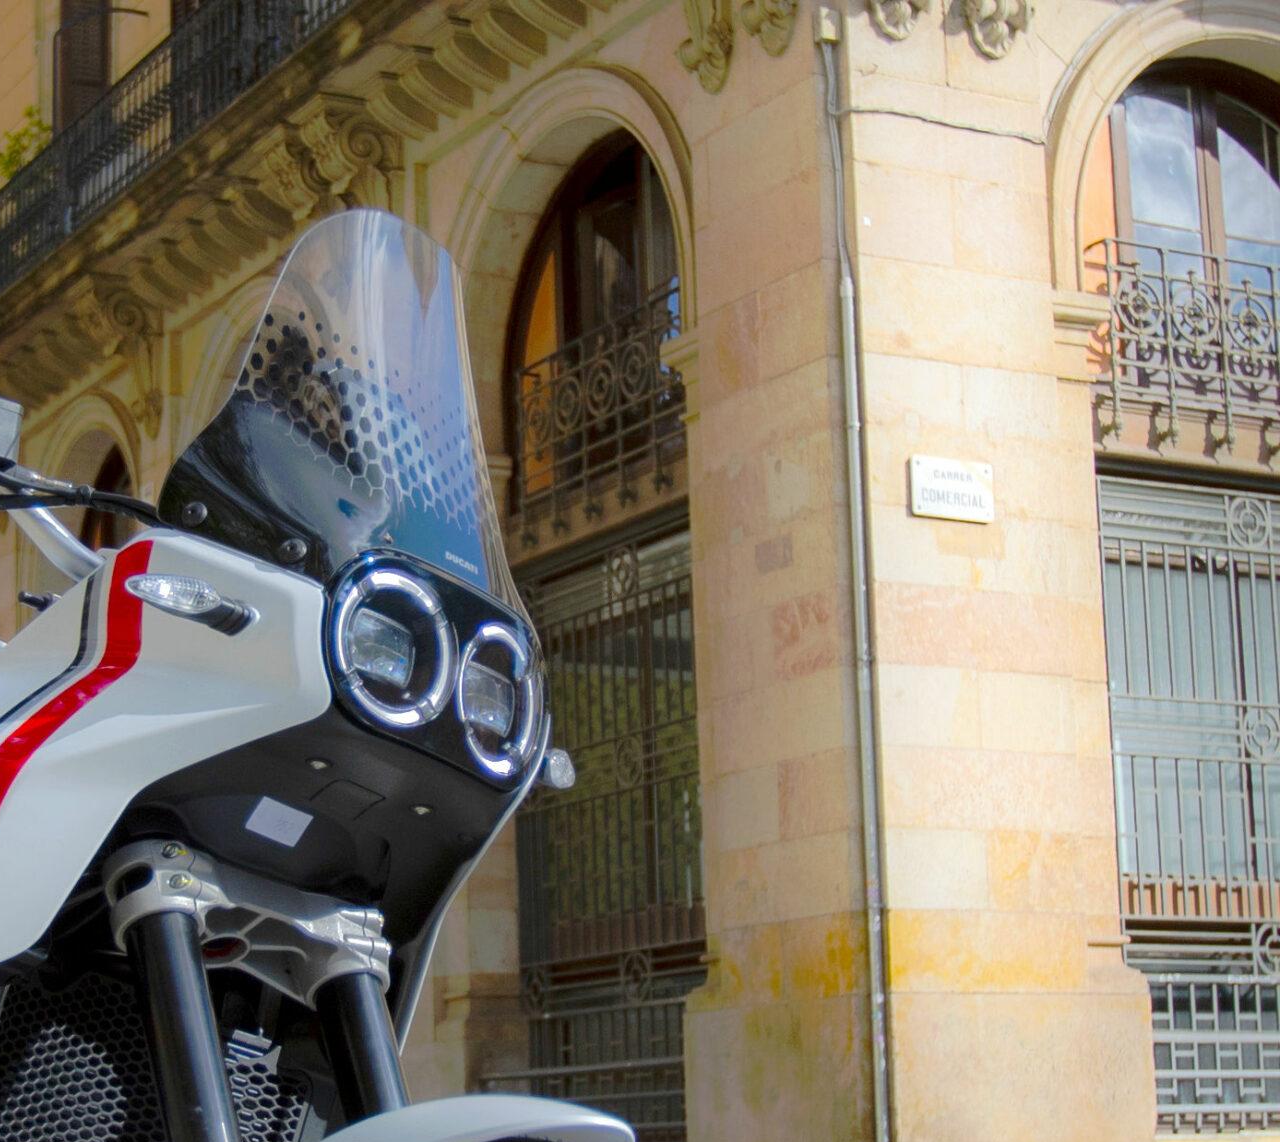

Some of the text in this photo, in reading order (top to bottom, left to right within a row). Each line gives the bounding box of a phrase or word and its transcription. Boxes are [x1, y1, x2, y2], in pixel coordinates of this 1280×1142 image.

[933, 469, 973, 483] CARRER
[921, 487, 987, 509] COMERCIAL
[445, 550, 479, 575] DUCATI
